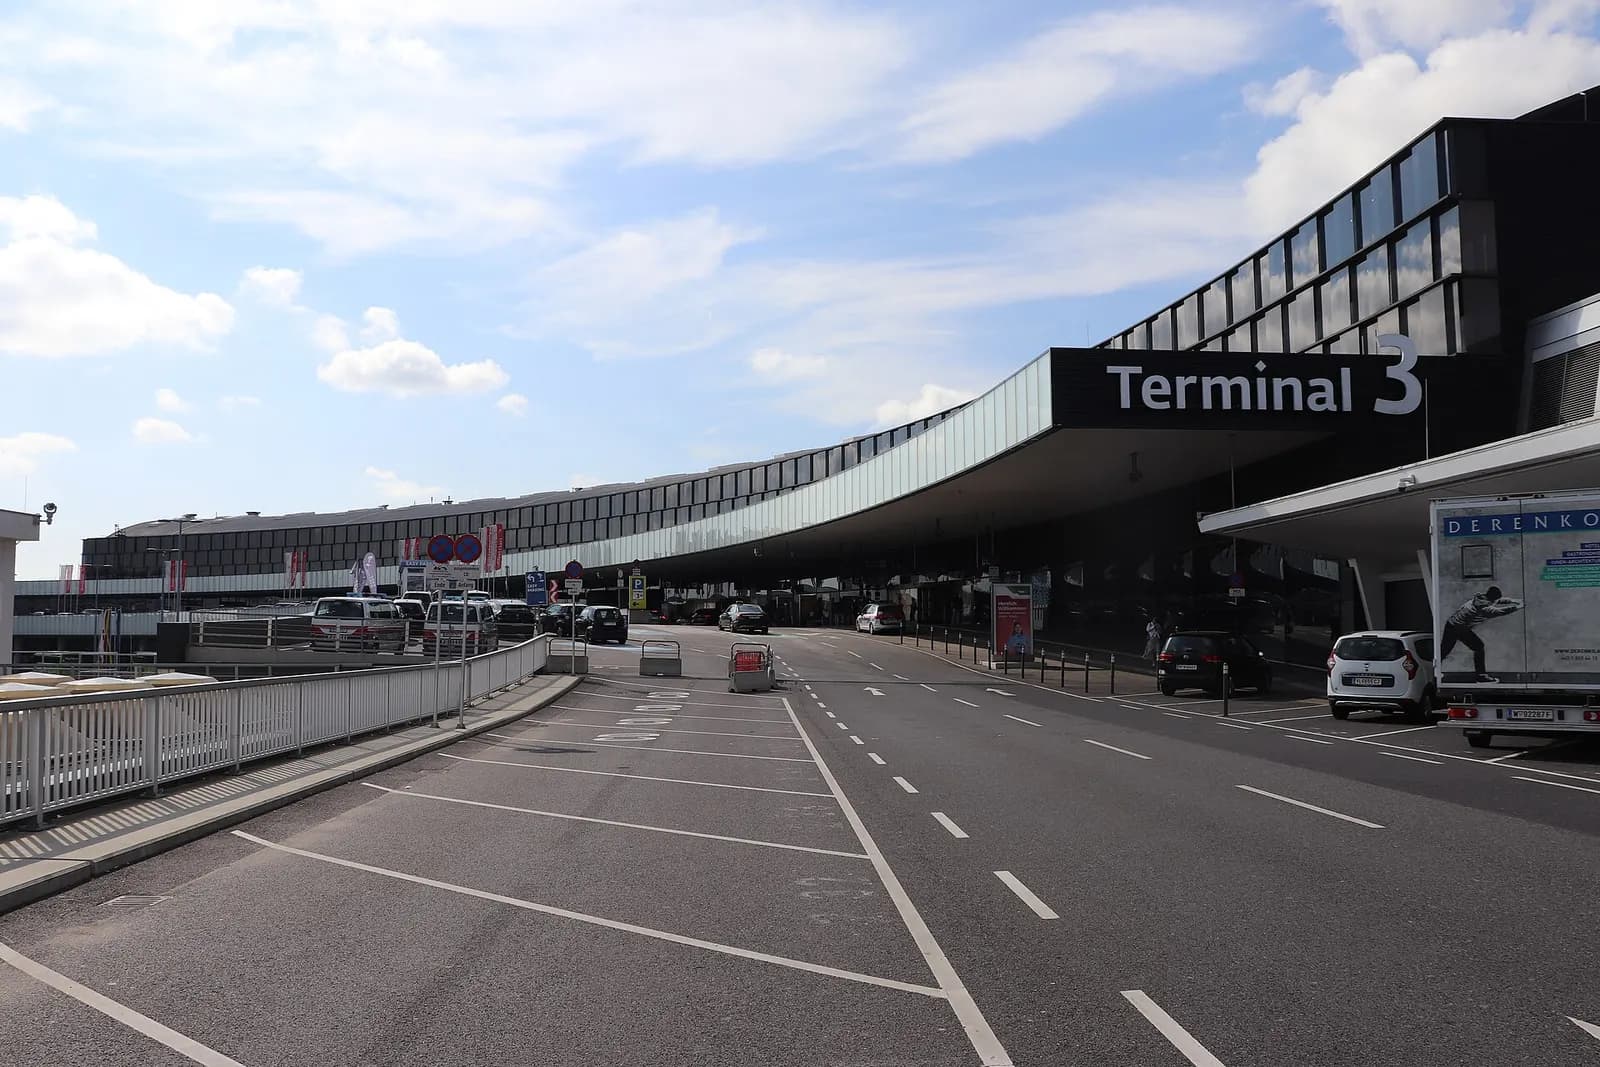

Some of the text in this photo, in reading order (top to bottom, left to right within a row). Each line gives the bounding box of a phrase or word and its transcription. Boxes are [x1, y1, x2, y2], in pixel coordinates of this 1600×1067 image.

[1106, 333, 1423, 416] Terminal 3
[1449, 512, 1600, 534] DERENKO
[634, 579, 642, 589] P
